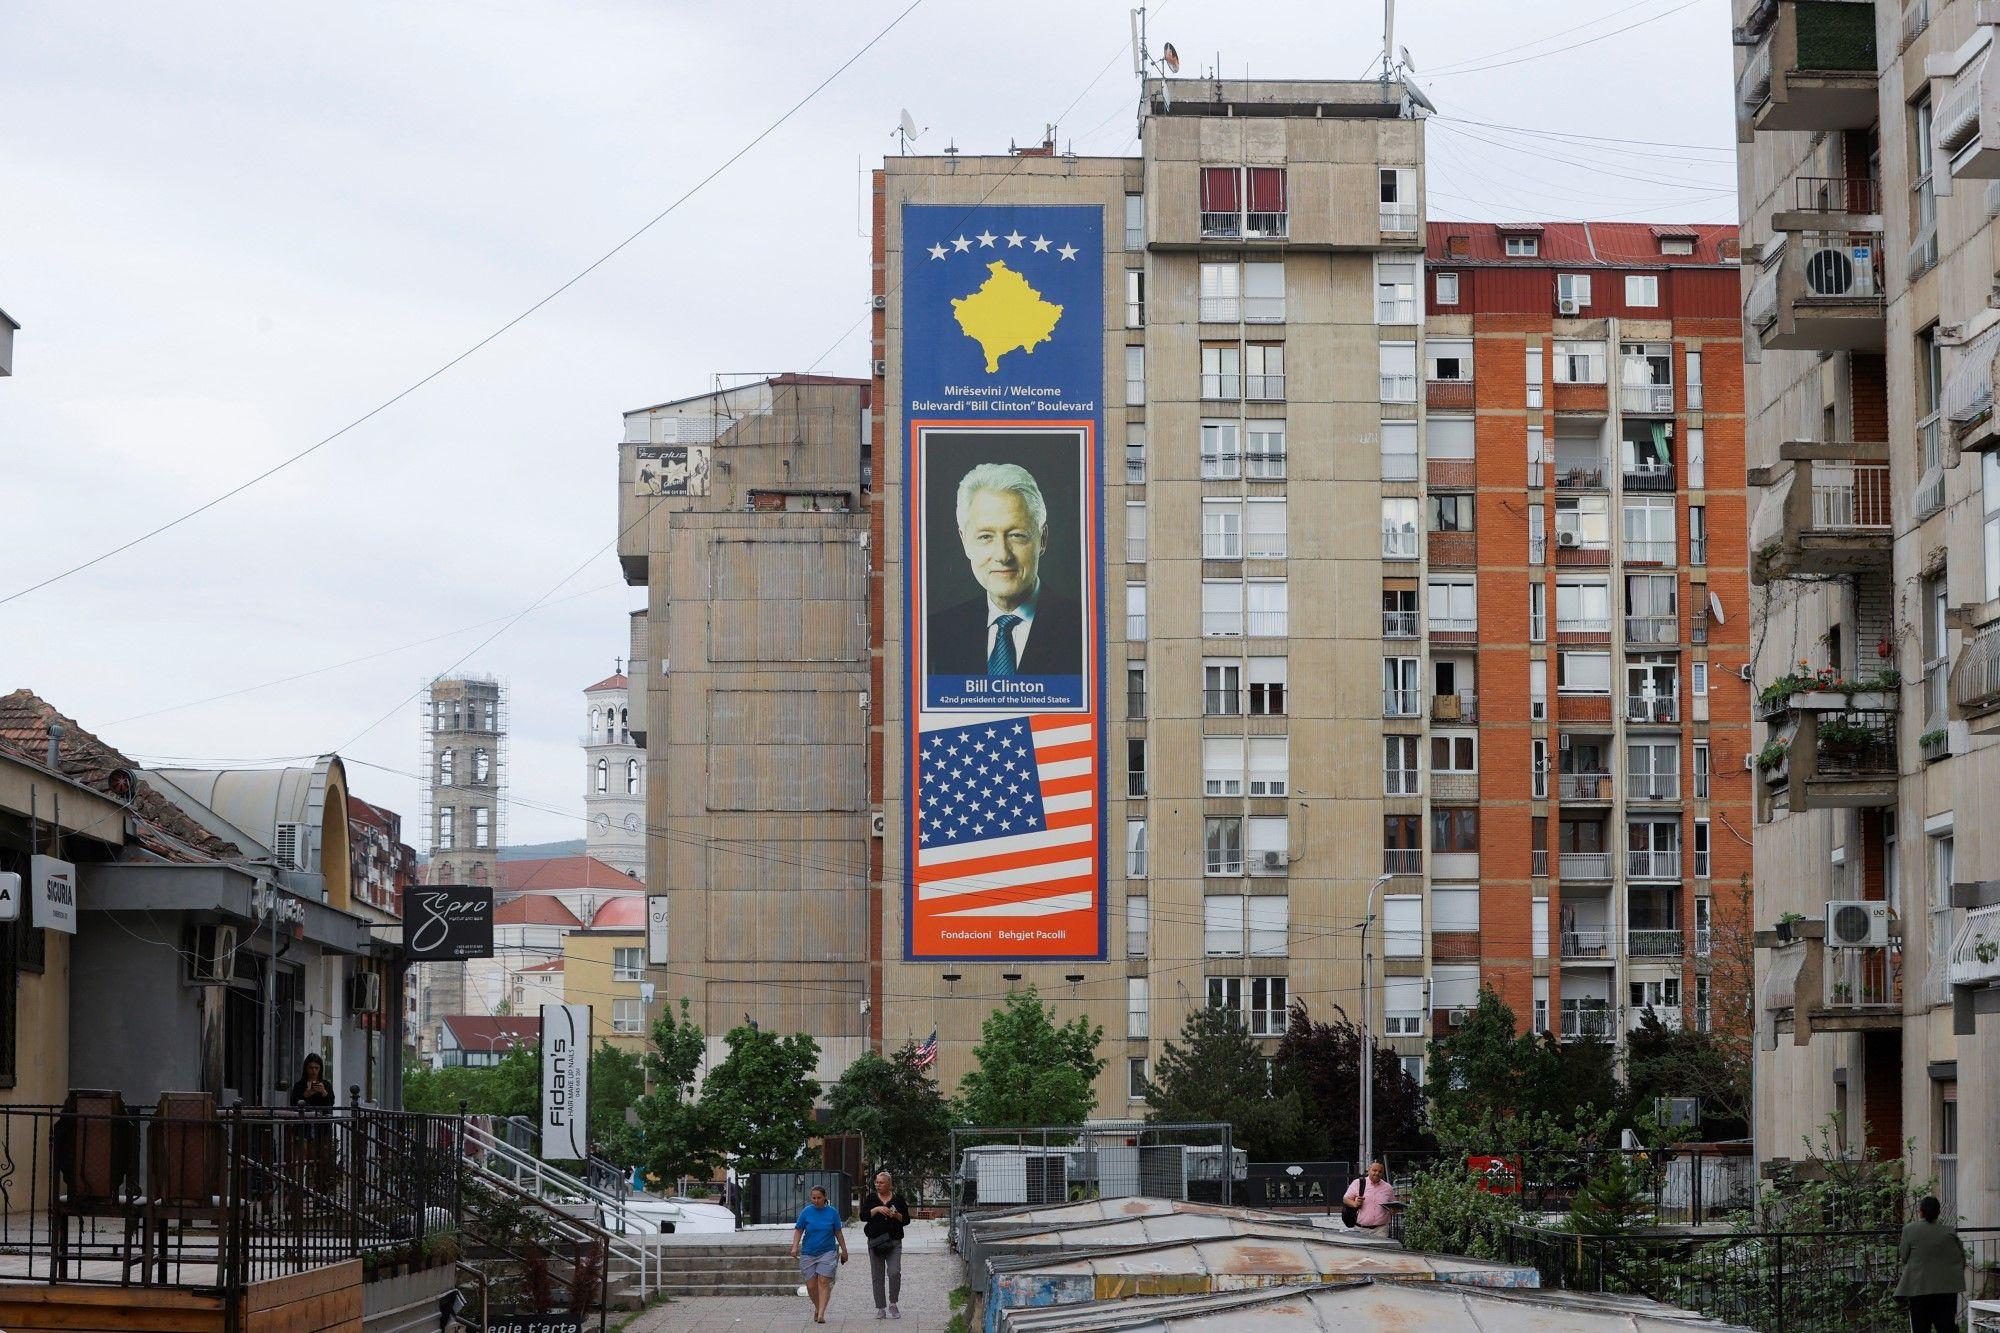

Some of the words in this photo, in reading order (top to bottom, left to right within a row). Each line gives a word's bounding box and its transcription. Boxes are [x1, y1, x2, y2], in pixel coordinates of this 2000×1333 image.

[944, 385, 1001, 396] Mirësevini
[1004, 386, 1009, 396] /
[1010, 386, 1061, 396] Welcome
[912, 400, 964, 411] Bulevardi
[1037, 400, 1094, 411] Boulevard
[965, 679, 987, 693] Bill
[991, 679, 1044, 693] Clinton
[939, 696, 959, 704] 42nd
[960, 695, 996, 705] president
[997, 695, 1005, 704] of
[1006, 696, 1019, 704] the
[1021, 696, 1046, 704] United
[1047, 696, 1071, 704] States
[940, 930, 992, 939] Fondacioni
[998, 930, 1034, 941] Behgjet
[1036, 930, 1066, 939] Pacolli
[568, 1069, 575, 1079] UP
[549, 1038, 566, 1127] Fidan's
